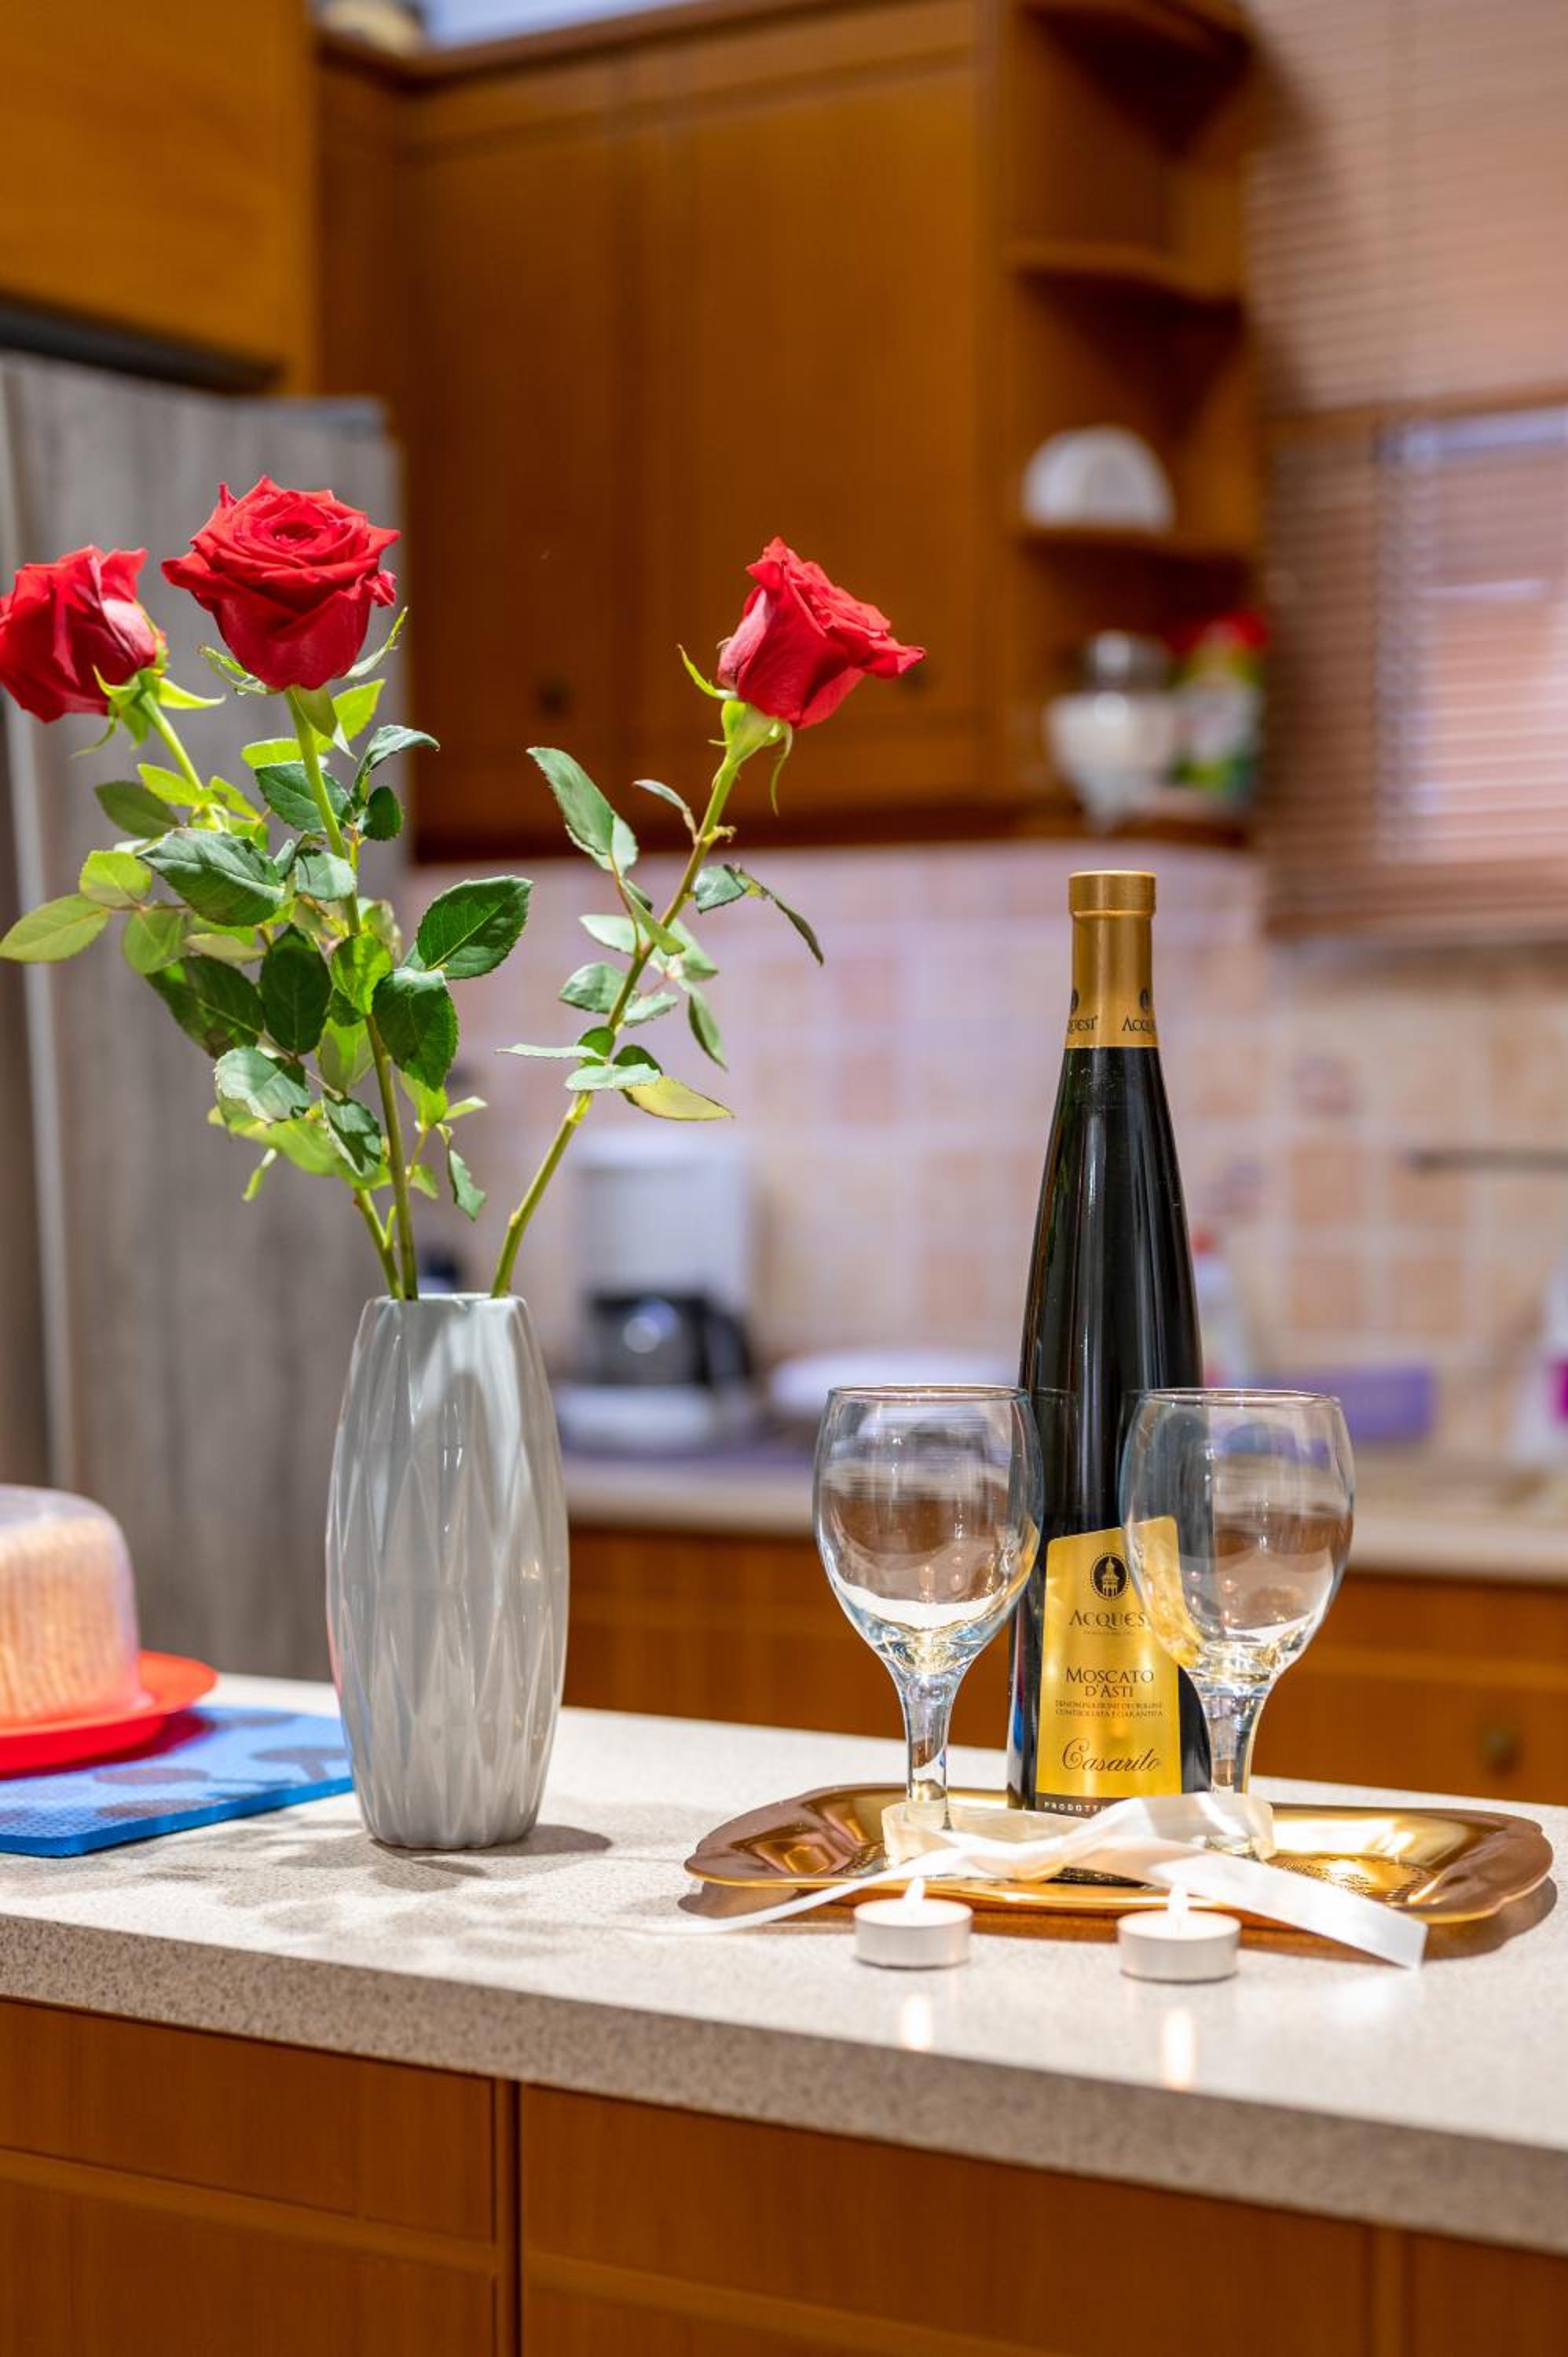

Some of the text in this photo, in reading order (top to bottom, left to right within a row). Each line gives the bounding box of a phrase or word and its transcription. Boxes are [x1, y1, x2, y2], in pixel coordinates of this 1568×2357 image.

[1068, 1609, 1145, 1629] ACQUES
[1066, 1666, 1154, 1684] MOSCATO
[1085, 1684, 1134, 1698] D'ASTI
